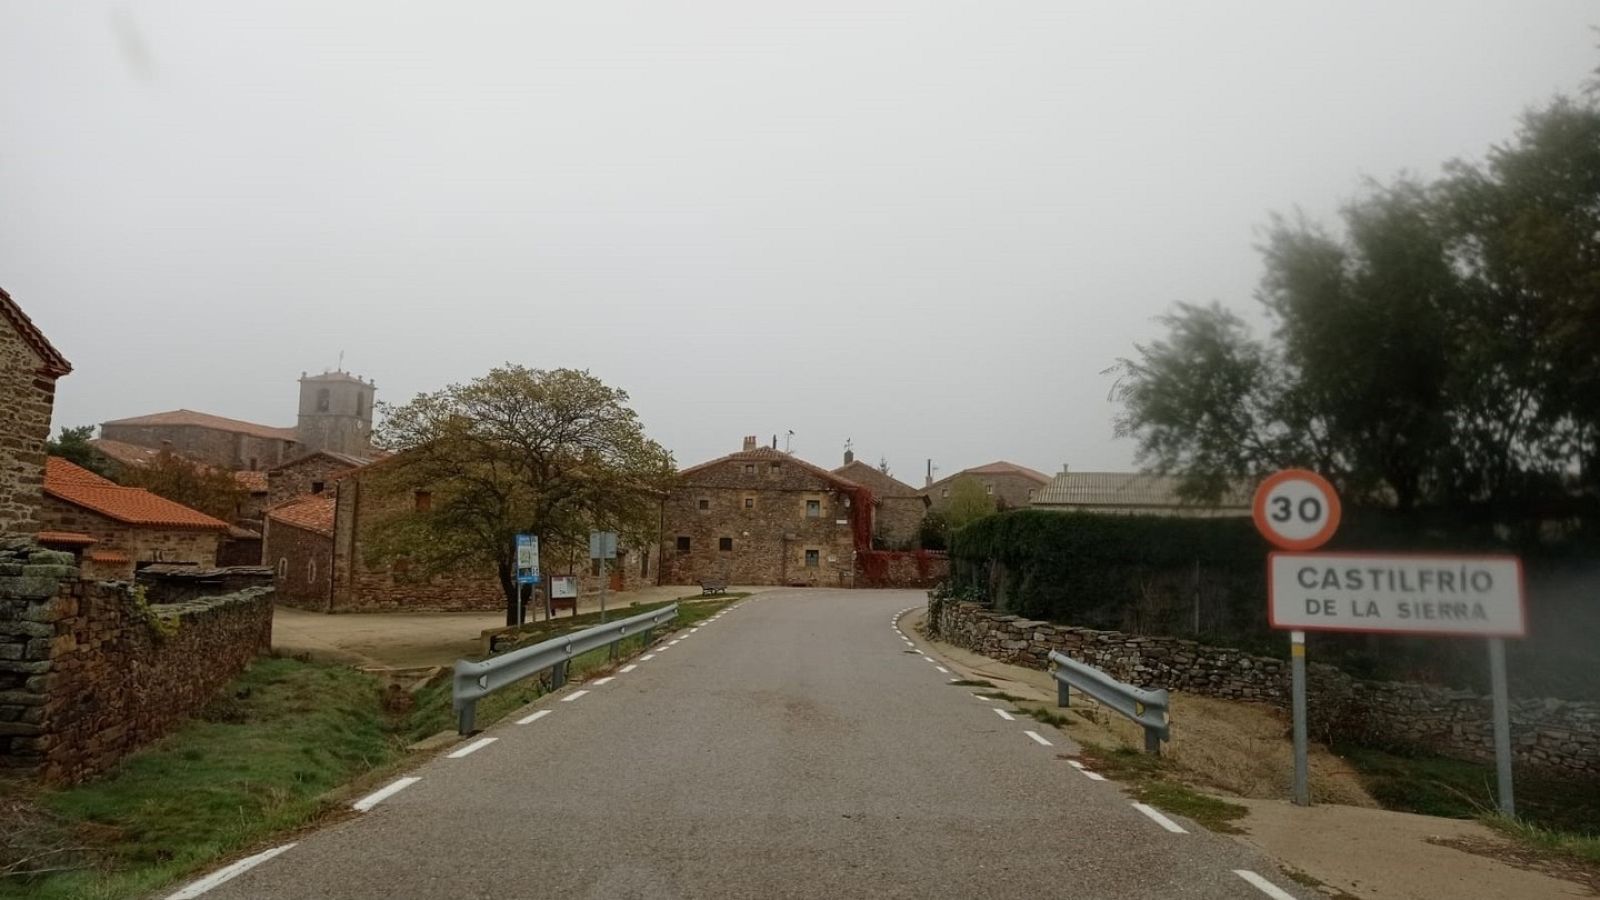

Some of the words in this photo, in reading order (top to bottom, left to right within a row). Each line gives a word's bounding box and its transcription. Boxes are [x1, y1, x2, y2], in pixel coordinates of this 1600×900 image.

[1271, 496, 1322, 523] 30
[1297, 565, 1493, 594] CASTILFRÍO
[1305, 599, 1337, 616] DE
[1352, 600, 1380, 618] LA
[1397, 602, 1487, 621] SIERRA
